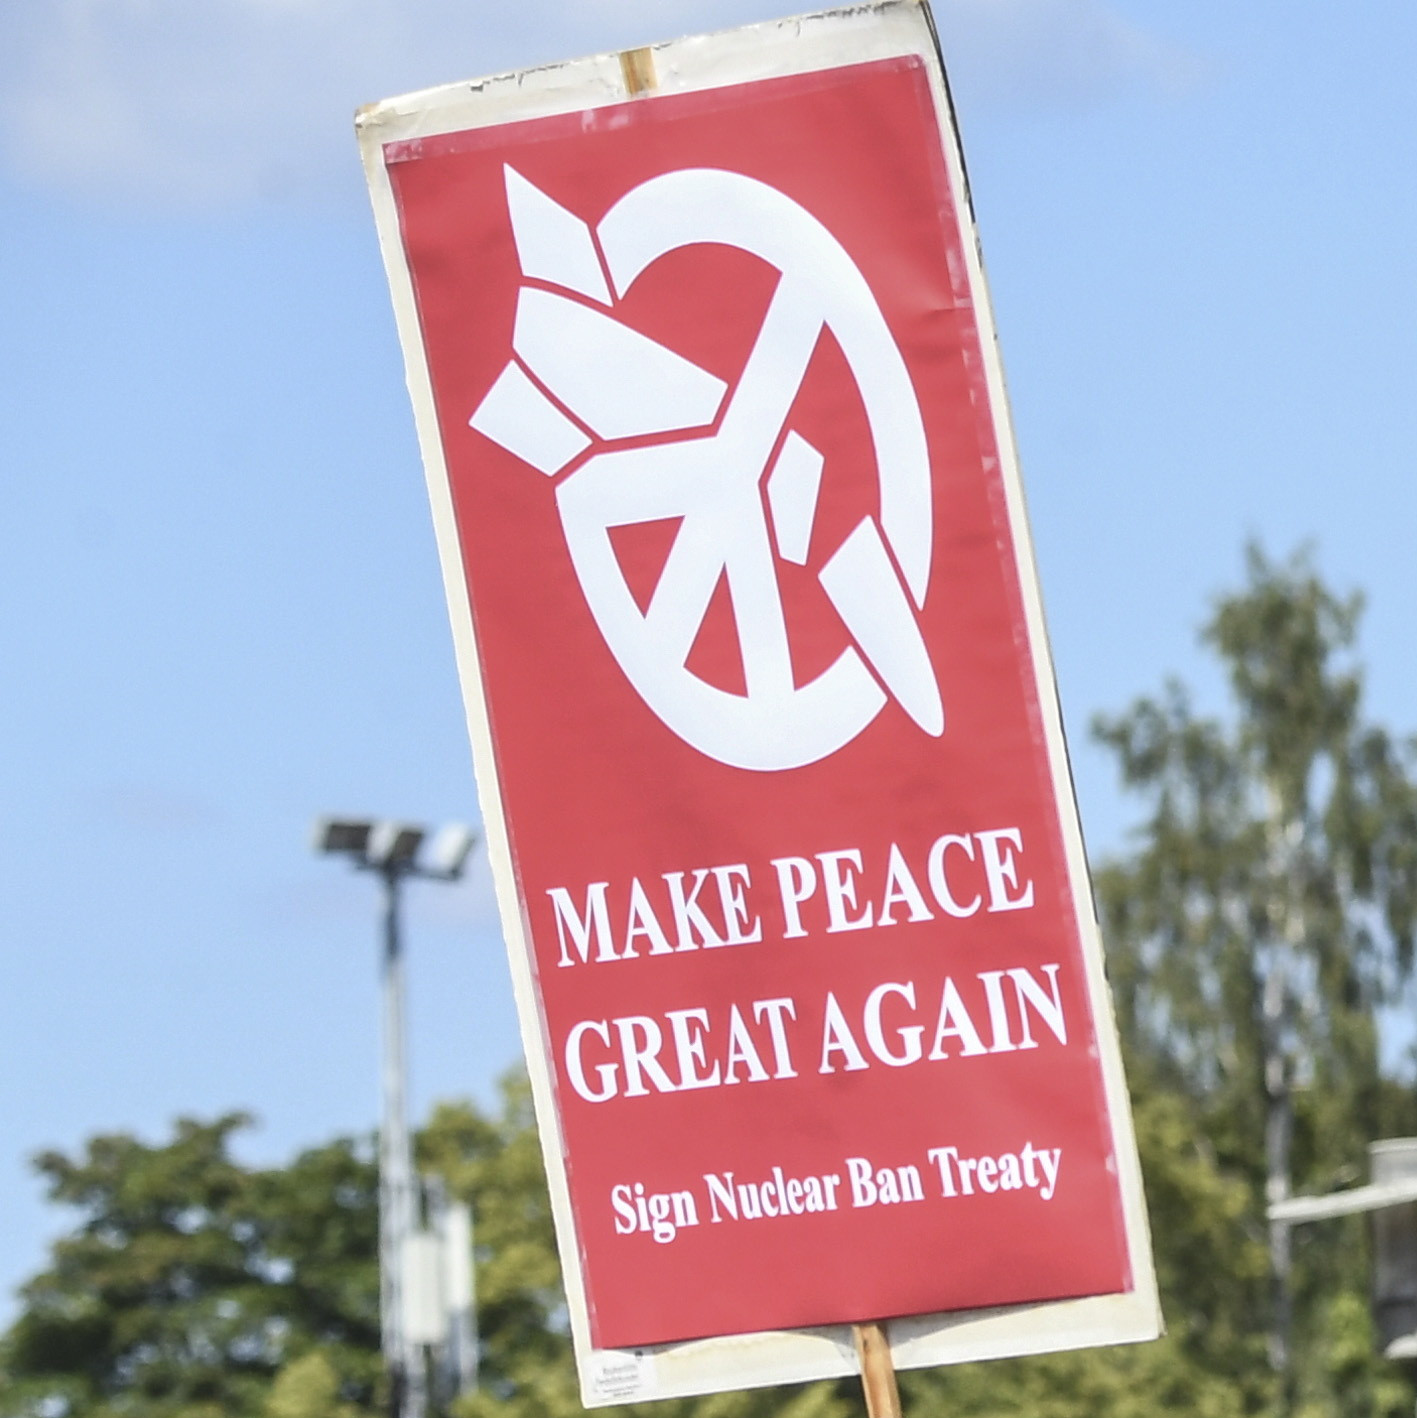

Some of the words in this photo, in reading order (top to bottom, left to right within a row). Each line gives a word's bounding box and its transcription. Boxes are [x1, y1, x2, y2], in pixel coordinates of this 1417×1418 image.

[546, 863, 763, 968] MAKE
[771, 828, 1035, 940] PEACE
[565, 998, 799, 1103] GREAT
[818, 964, 1069, 1075] AGAIN
[610, 1184, 699, 1244] Sign
[703, 1167, 839, 1223] Nuclear
[846, 1157, 924, 1208] Ban
[929, 1142, 1062, 1199] Treaty
